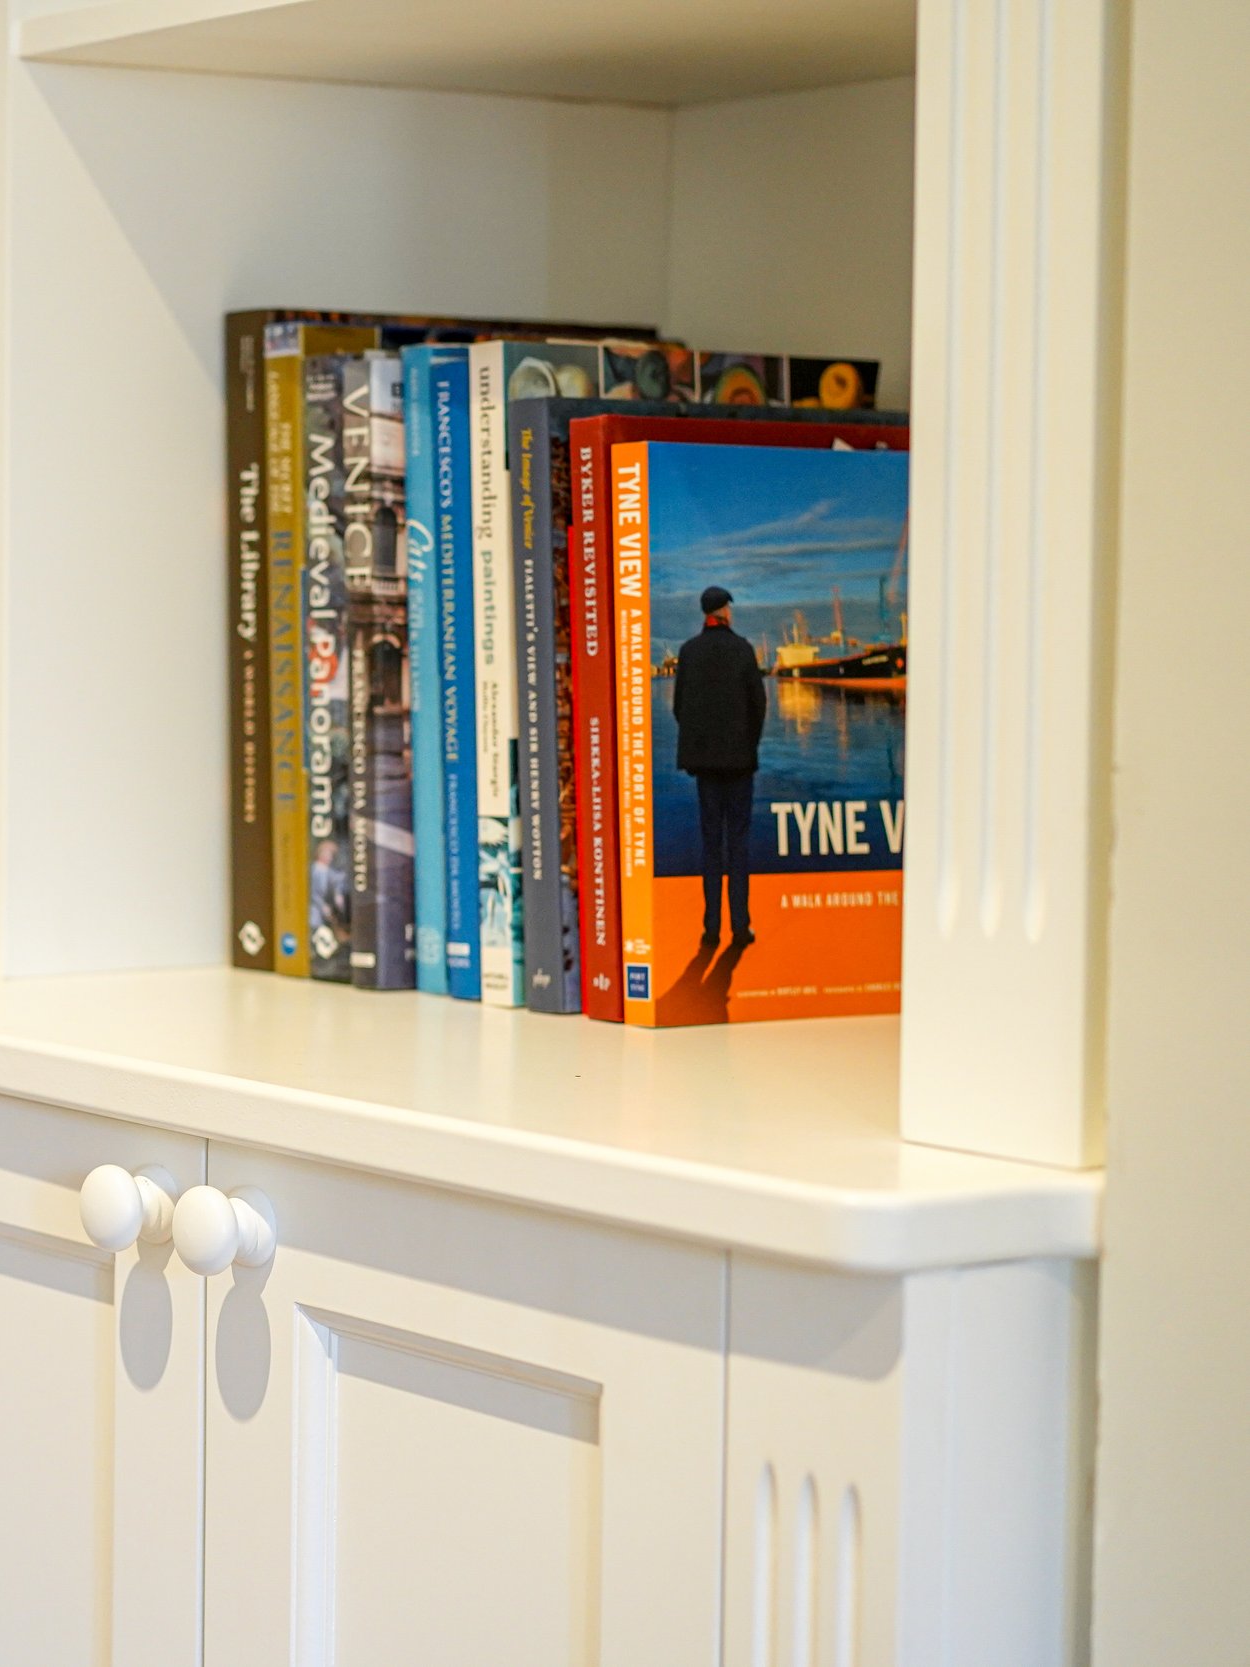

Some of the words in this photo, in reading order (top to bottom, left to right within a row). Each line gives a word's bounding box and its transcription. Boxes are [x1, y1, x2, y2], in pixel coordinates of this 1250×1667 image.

[477, 366, 498, 539] understanding
[580, 446, 596, 523] BYKER
[239, 462, 261, 523] The
[343, 384, 372, 589] VENICE
[617, 462, 642, 526] TYNE
[308, 433, 338, 619] Medieval
[236, 530, 261, 641] Library
[440, 514, 458, 680] MEDITERRANEAN
[582, 530, 599, 657] REVISITED
[619, 532, 643, 598] VIEW
[481, 549, 498, 665] paintings
[630, 608, 643, 618] A
[526, 645, 538, 686] VIEW
[631, 622, 644, 662] WALK
[444, 686, 459, 764] VOYAGE
[527, 689, 539, 723] AND
[631, 666, 645, 726] AROUND
[309, 631, 337, 838] Panorama
[528, 726, 540, 753] SIR
[632, 730, 645, 758] THE
[529, 757, 541, 810] HENRY
[589, 716, 603, 832] SIRKKA-LIISA
[632, 763, 646, 801] PORT
[531, 813, 543, 880] WOTTON
[633, 806, 646, 825] OF
[770, 801, 871, 857] TYNE
[634, 831, 646, 867] TYNE
[592, 836, 606, 946] KONTTINEN
[780, 894, 789, 909] A
[791, 892, 823, 909] WALK
[825, 890, 873, 907] AROUND
[877, 889, 899, 906] THE
